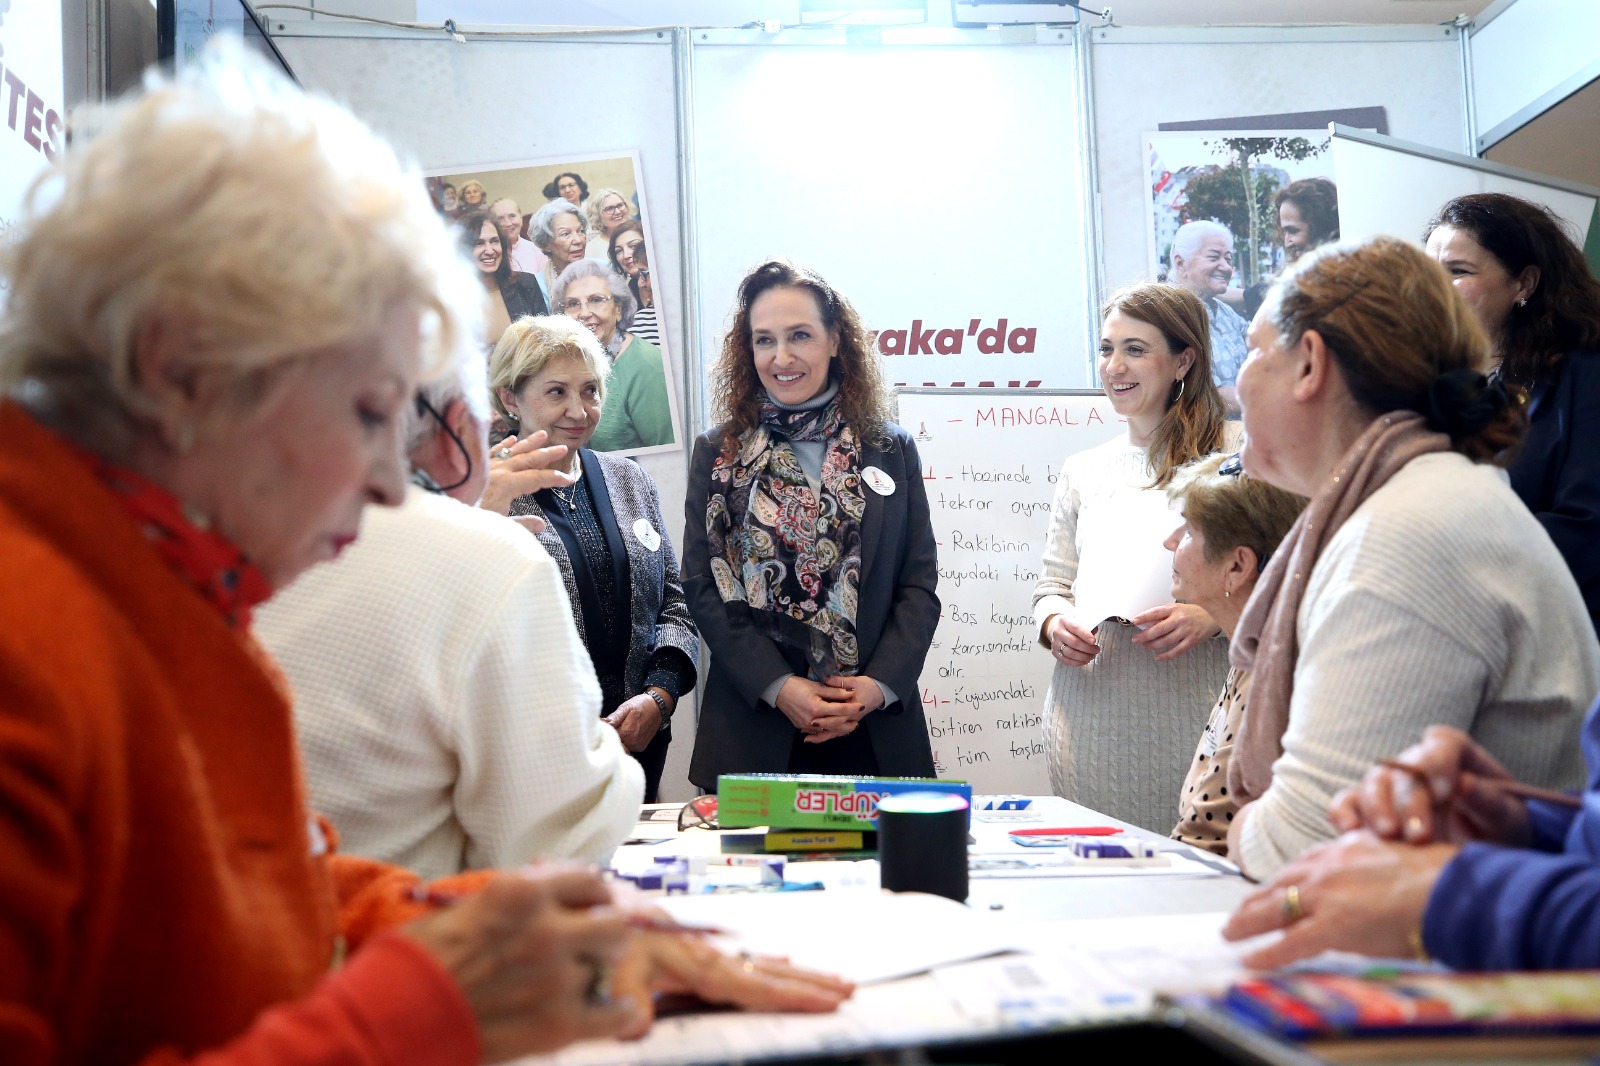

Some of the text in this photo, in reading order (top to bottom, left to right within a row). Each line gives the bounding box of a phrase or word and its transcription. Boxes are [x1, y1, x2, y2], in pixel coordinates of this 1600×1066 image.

[1047, 465, 1061, 484] b
[938, 492, 994, 510] tekrar
[952, 530, 1030, 553] Rakibinin
[1013, 564, 1039, 582] tüm
[949, 604, 978, 626] Boş
[929, 716, 983, 738] bitiren
[957, 746, 991, 767] tüm
